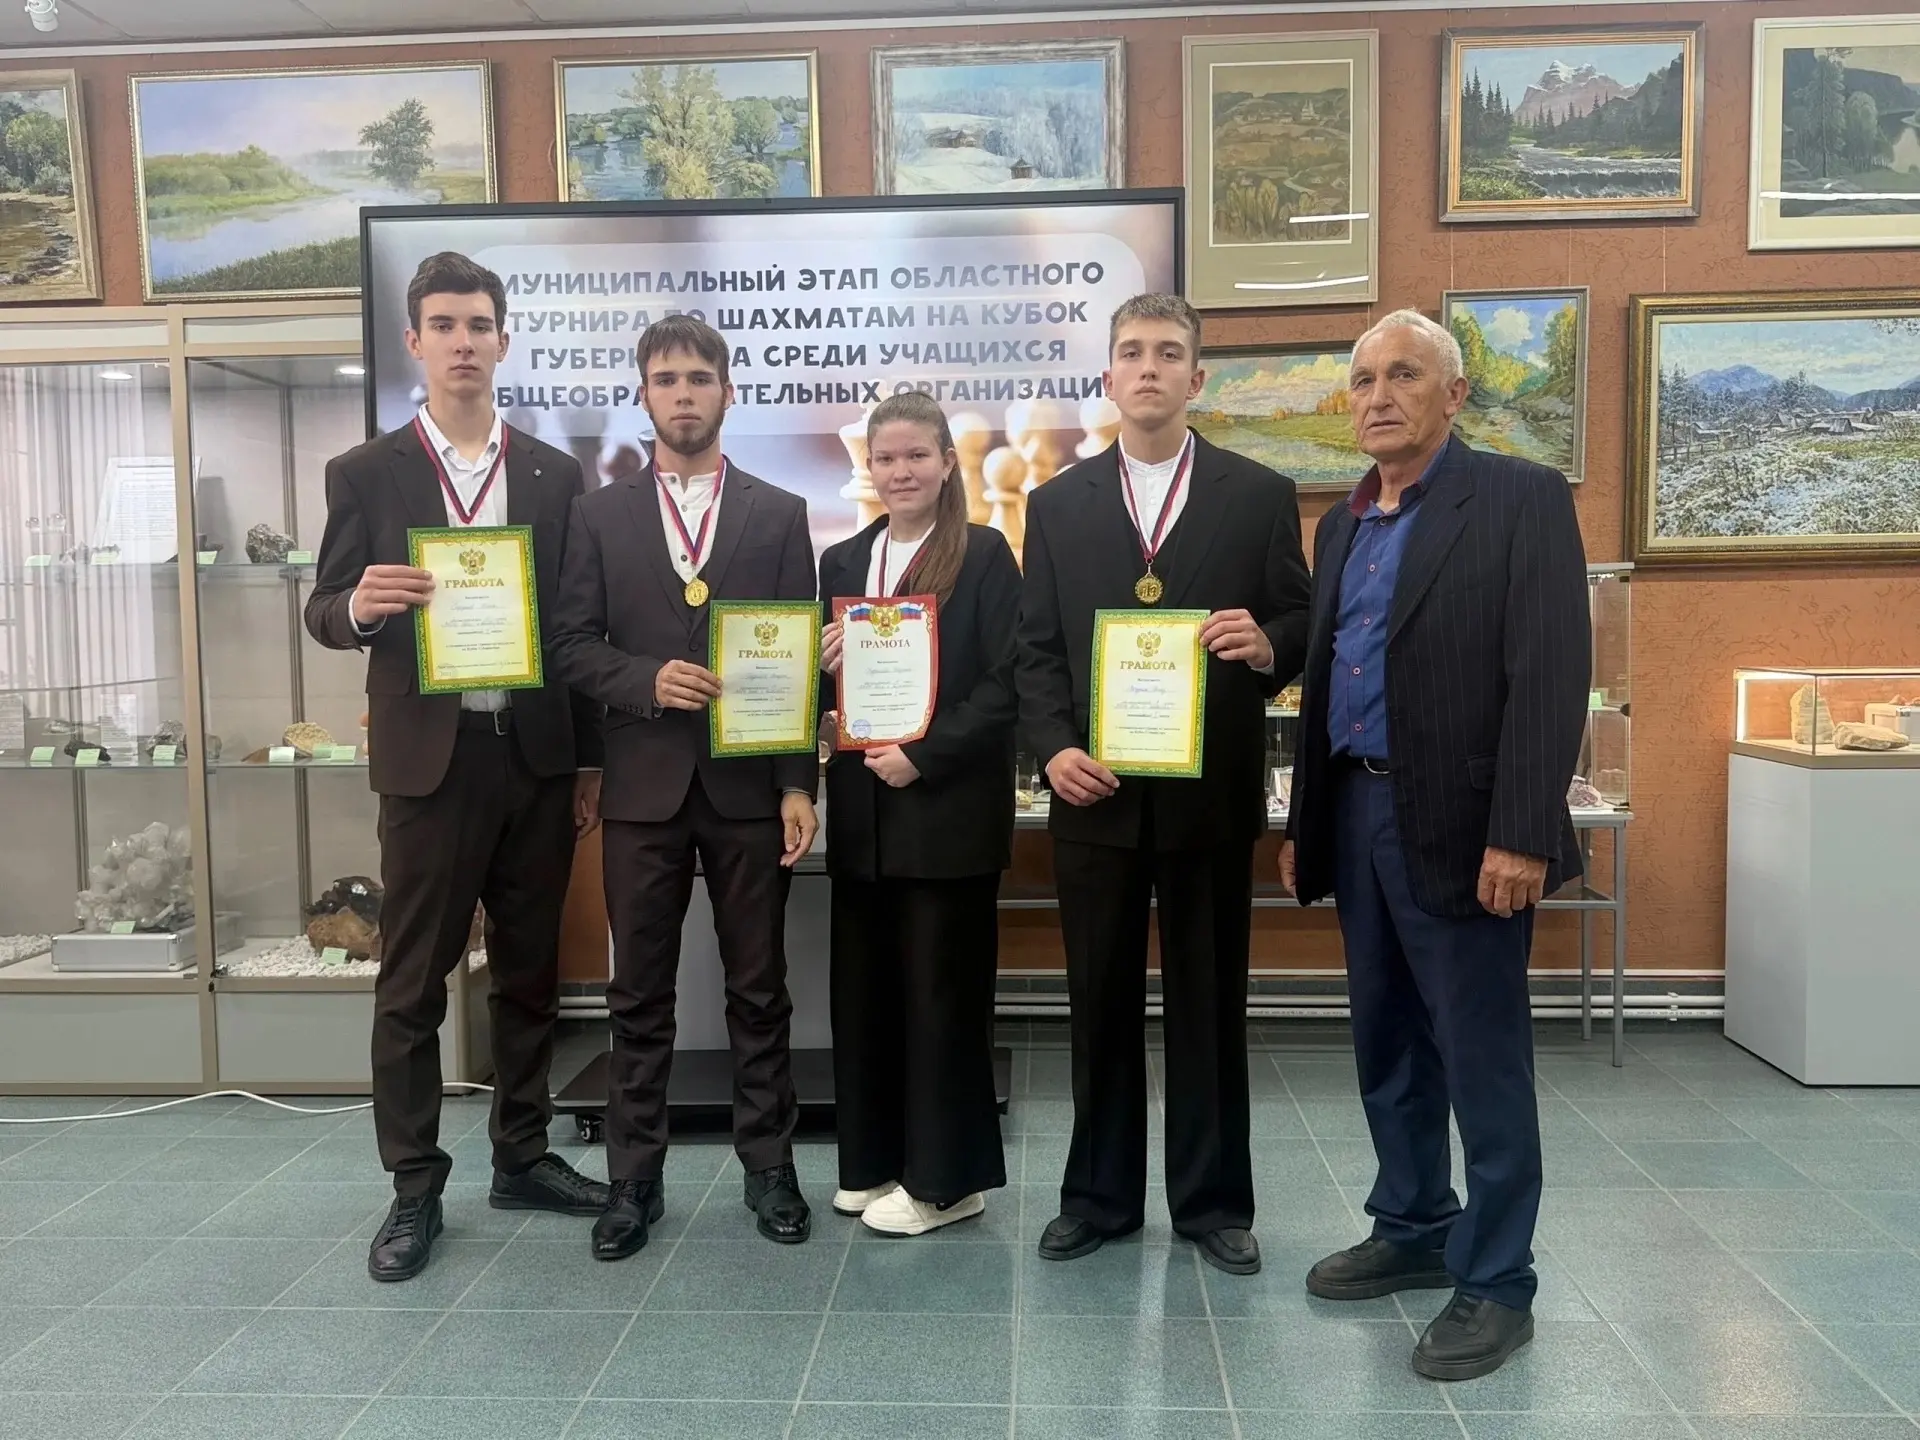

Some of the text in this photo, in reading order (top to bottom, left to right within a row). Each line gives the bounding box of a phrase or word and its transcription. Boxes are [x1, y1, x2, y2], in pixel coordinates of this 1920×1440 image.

[797, 267, 878, 291] ЭТАП
[890, 261, 1104, 290] ОБЛАСТНОГО
[508, 309, 651, 333] ТУРНИРА
[718, 306, 915, 330] ШАХМАТАМ
[927, 304, 969, 326] НА
[981, 301, 1088, 325] КУБОК
[763, 344, 866, 369] СРЕДИ
[879, 339, 1066, 366] УЧАЩИХСЯ
[444, 577, 505, 589] ГРАМОТА
[860, 638, 911, 649] ГРАМОТА
[738, 649, 793, 659] ГРАМОТА
[1120, 660, 1176, 671] ГРАМОТА
